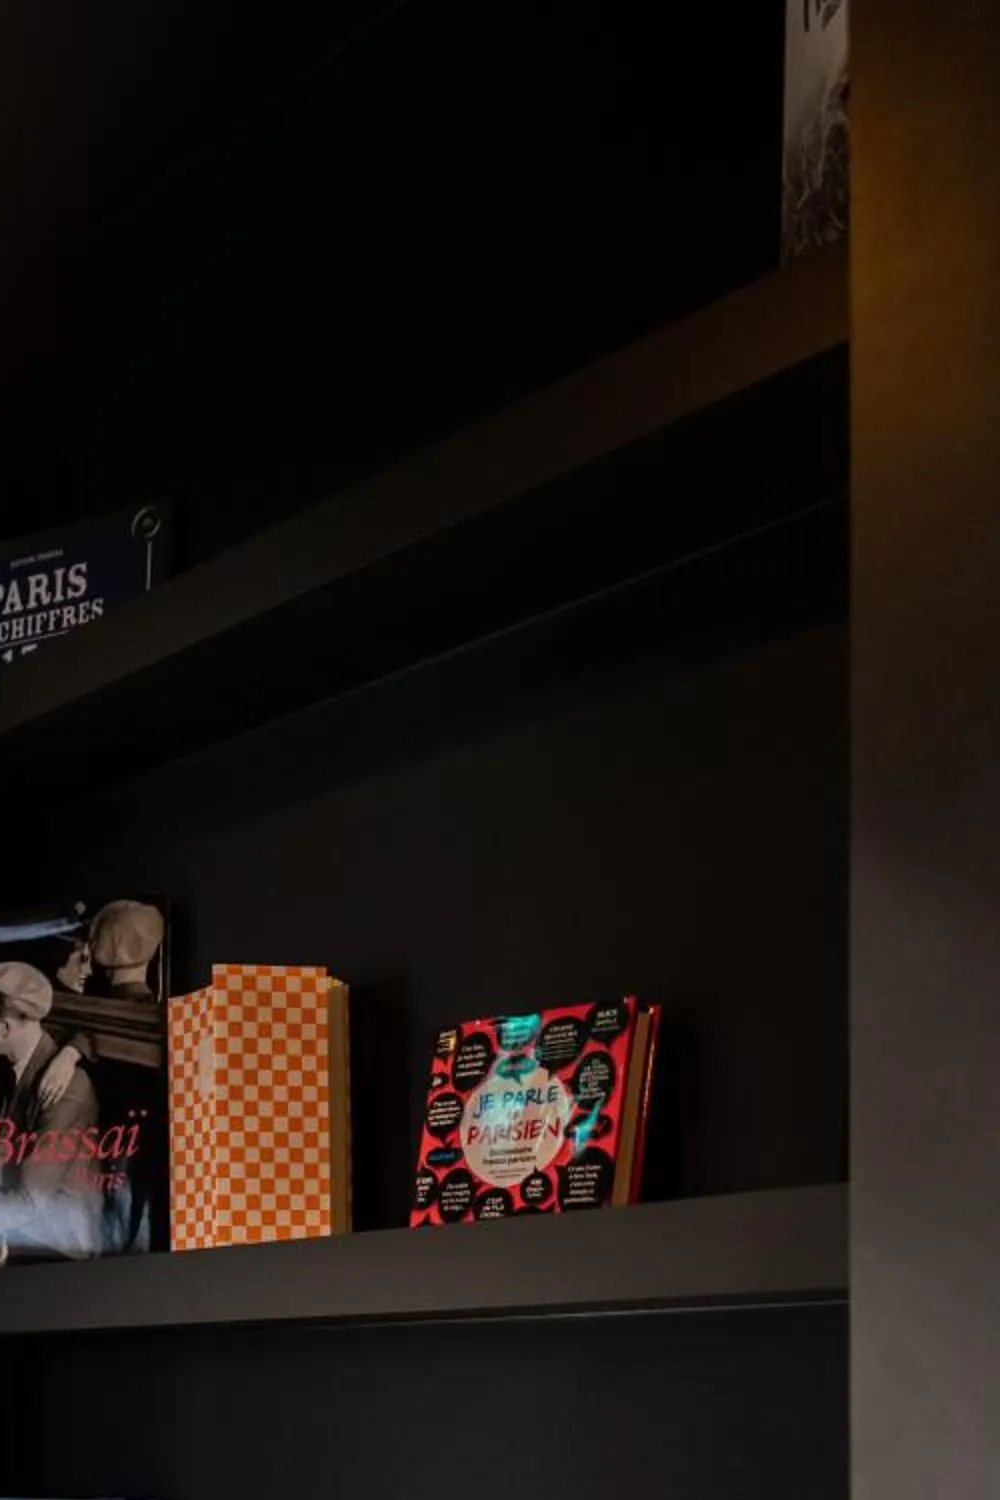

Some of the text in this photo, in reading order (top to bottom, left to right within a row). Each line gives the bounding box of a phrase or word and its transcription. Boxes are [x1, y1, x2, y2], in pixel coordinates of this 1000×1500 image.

[473, 1092, 495, 1119] JE
[502, 1085, 560, 1107] PARLE
[467, 1116, 561, 1146] PARISIEN
